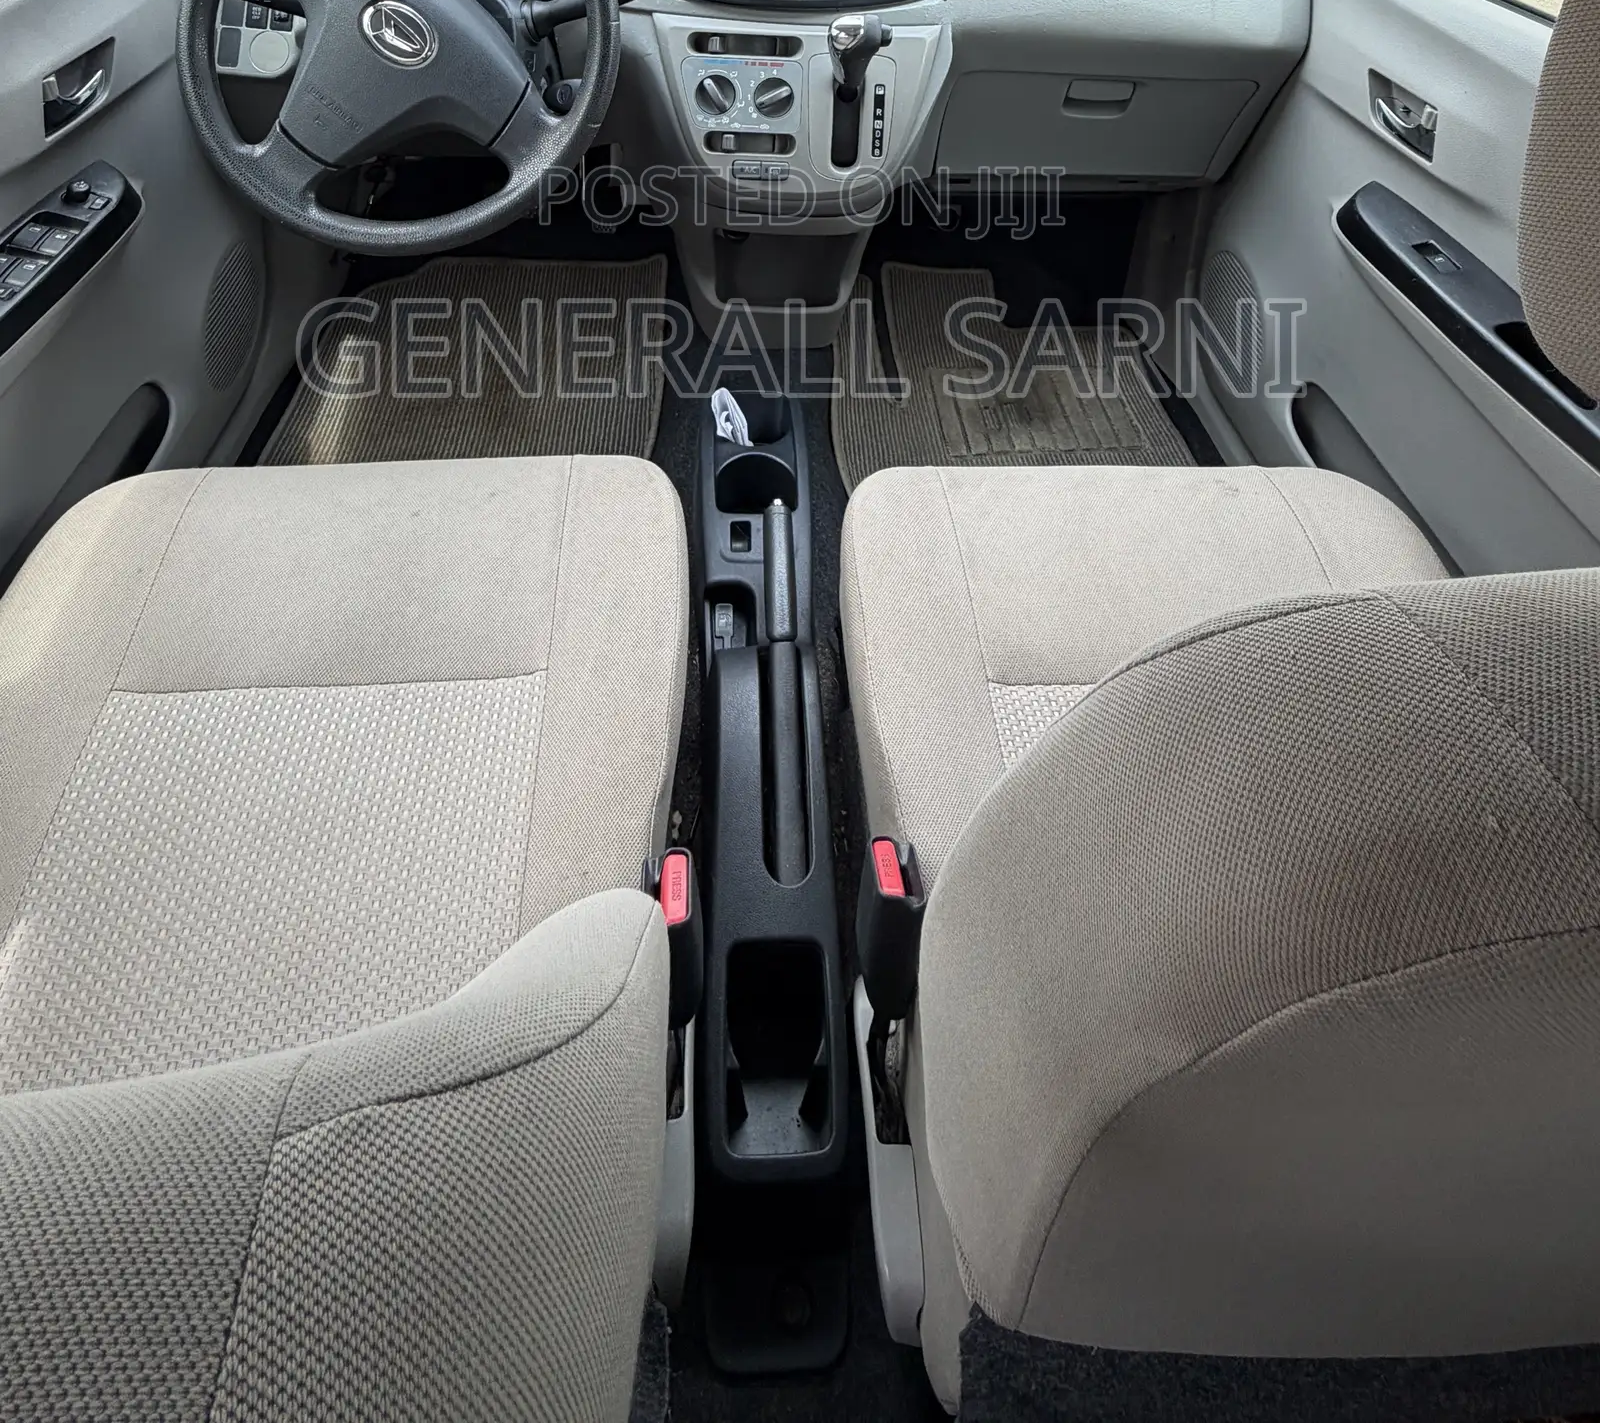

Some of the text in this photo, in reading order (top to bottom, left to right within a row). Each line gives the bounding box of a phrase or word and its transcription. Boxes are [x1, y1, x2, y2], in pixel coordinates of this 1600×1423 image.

[749, 106, 754, 114] 0
[876, 108, 882, 116] R
[875, 130, 881, 138] D
[874, 139, 880, 147] S
[874, 148, 880, 156] B
[671, 870, 682, 901] PRESS
